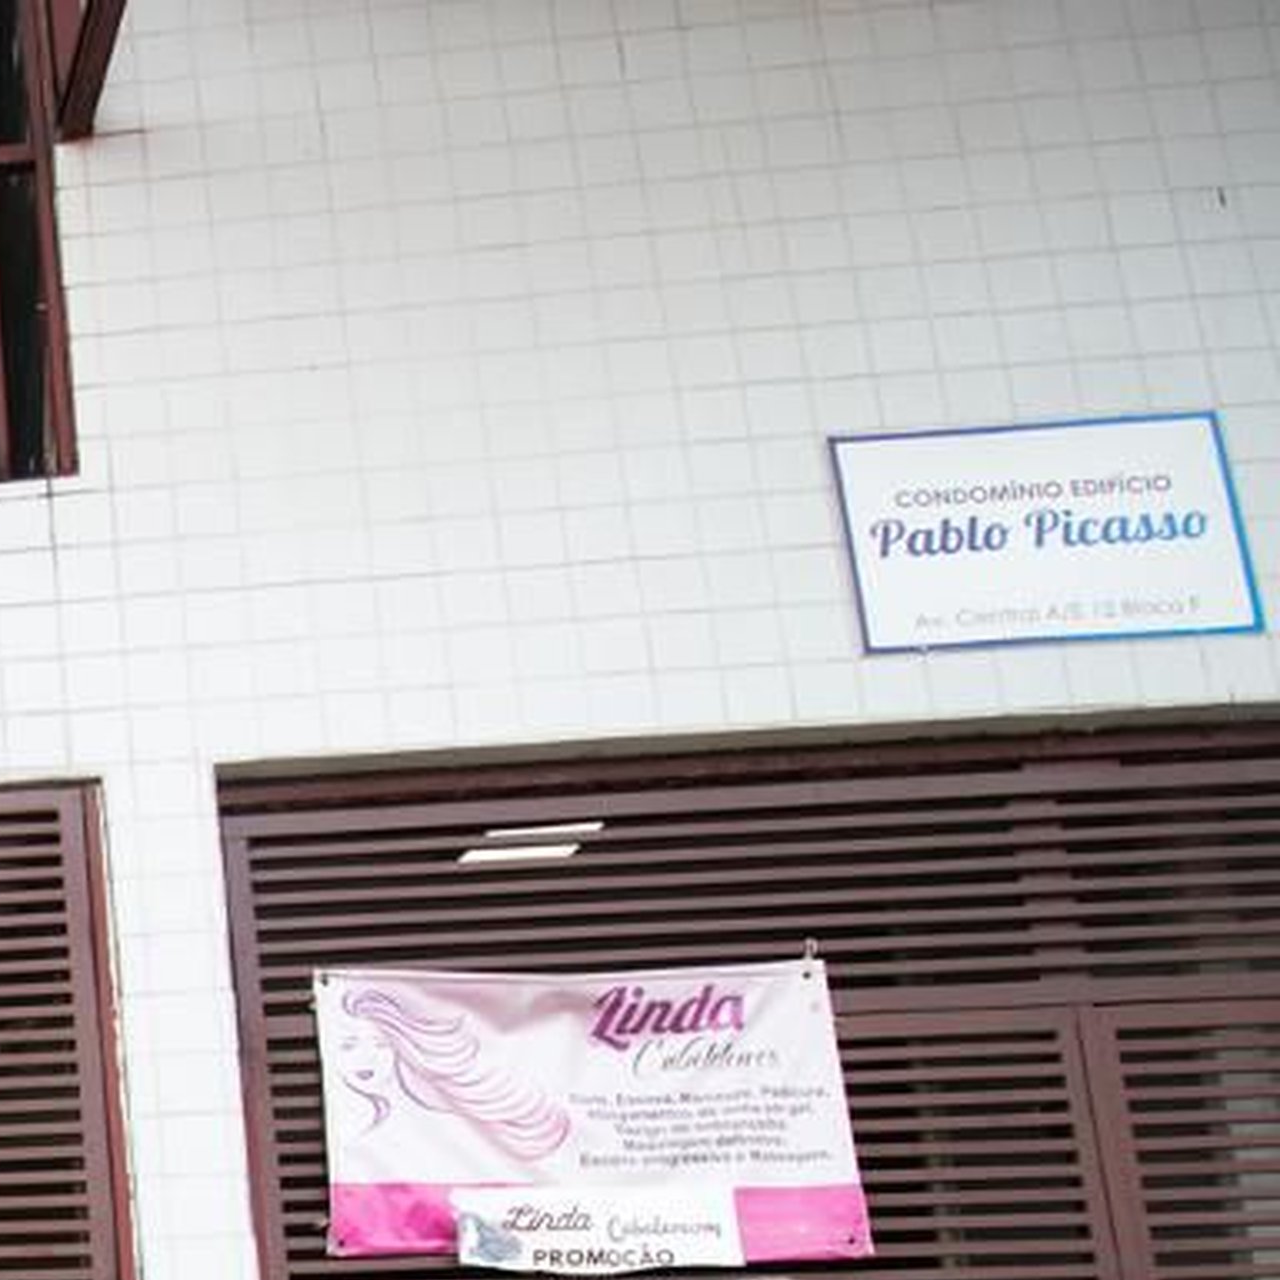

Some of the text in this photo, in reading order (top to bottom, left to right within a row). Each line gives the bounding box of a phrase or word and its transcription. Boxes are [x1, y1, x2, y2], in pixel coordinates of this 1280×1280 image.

[895, 482, 1062, 508] CONDOMÍNIO
[870, 509, 1207, 559] Pablo Picasso
[590, 984, 745, 1051] Linda
[502, 1203, 592, 1232] Linda
[532, 1243, 675, 1267] PROMOÇÃO
